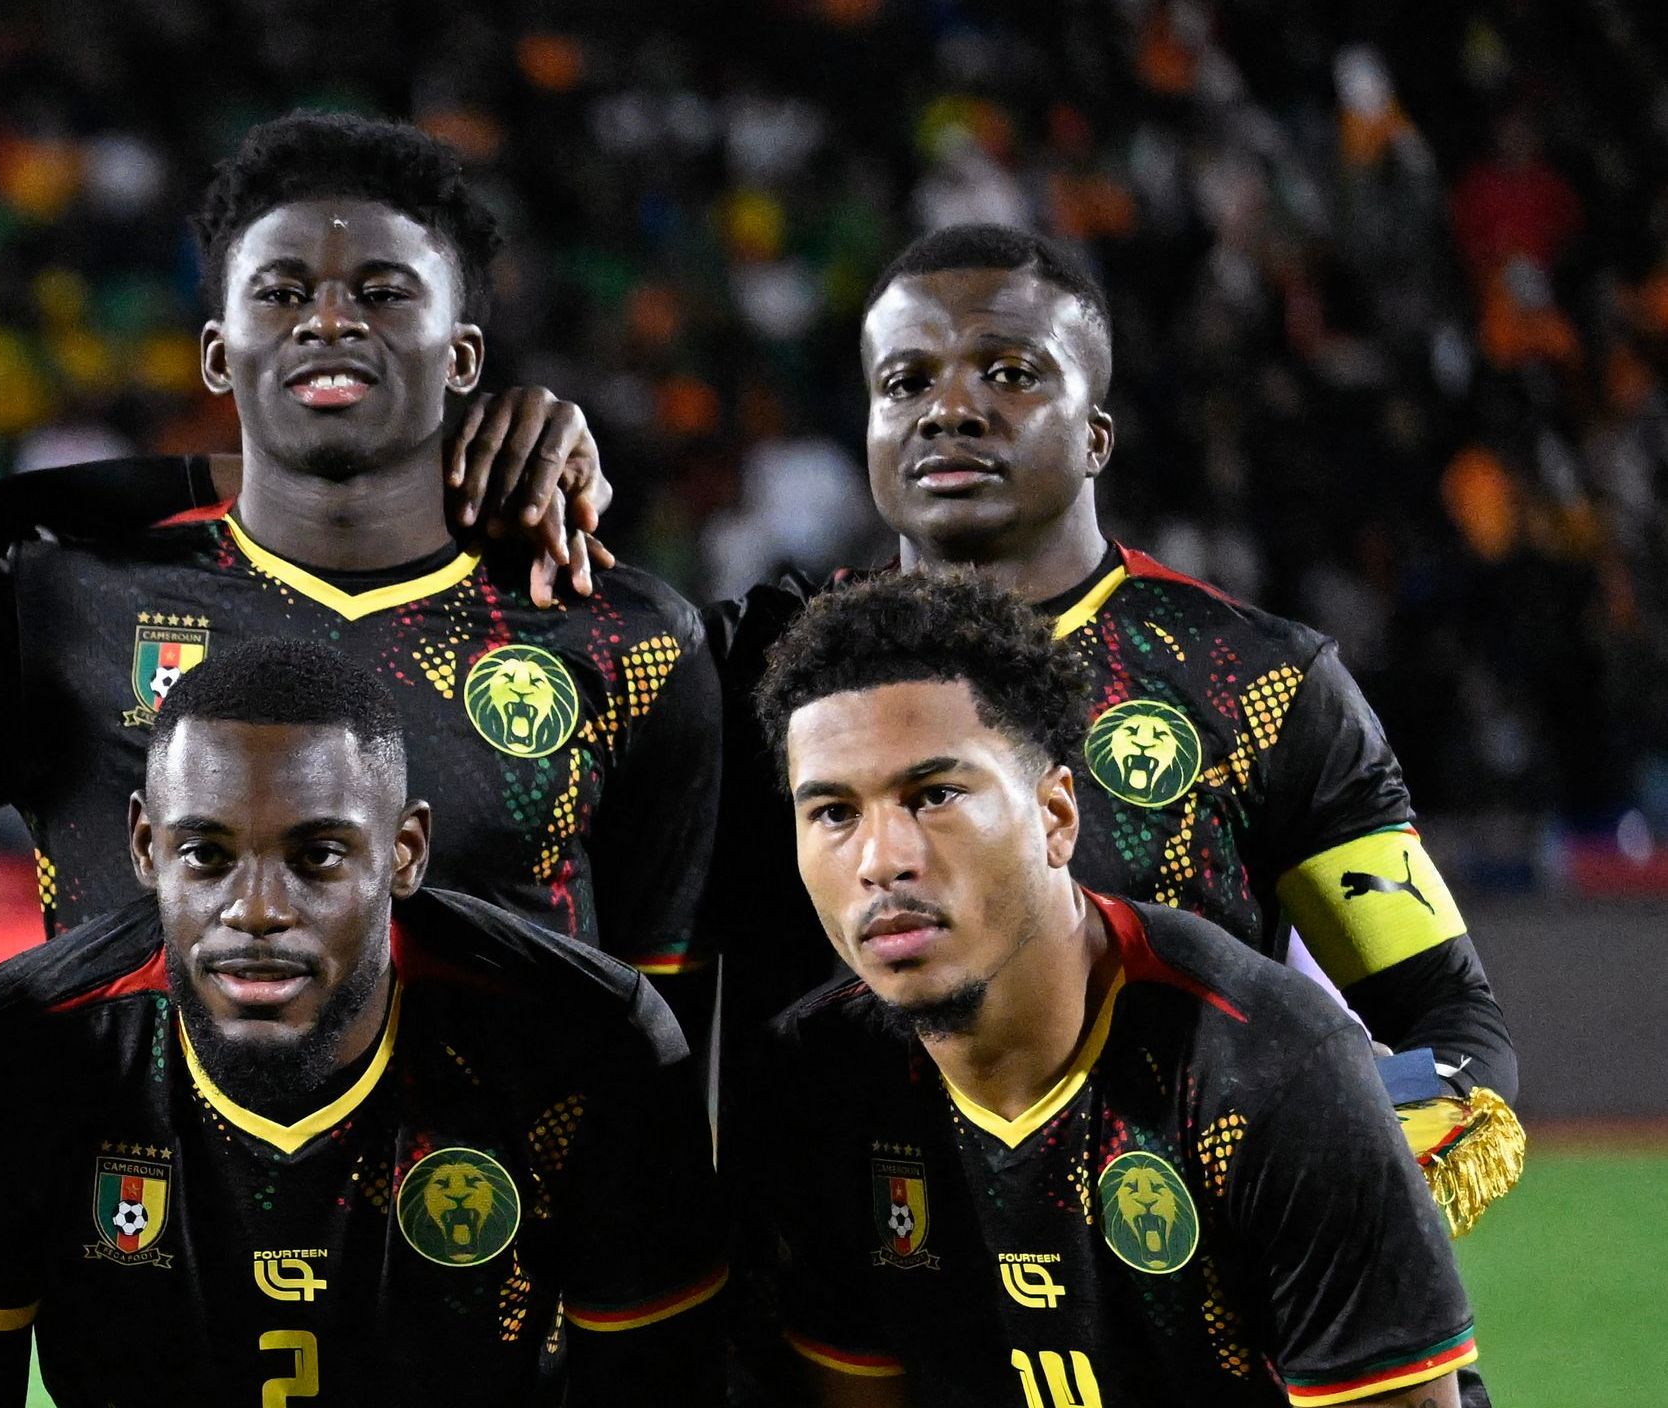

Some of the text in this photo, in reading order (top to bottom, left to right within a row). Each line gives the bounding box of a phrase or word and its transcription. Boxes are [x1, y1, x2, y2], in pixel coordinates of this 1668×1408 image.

[142, 631, 203, 644] CAMEROUN
[103, 1159, 165, 1178] CAMEROUN
[253, 1248, 329, 1261] FOURTEEN
[998, 1252, 1061, 1264] FOURTEEN
